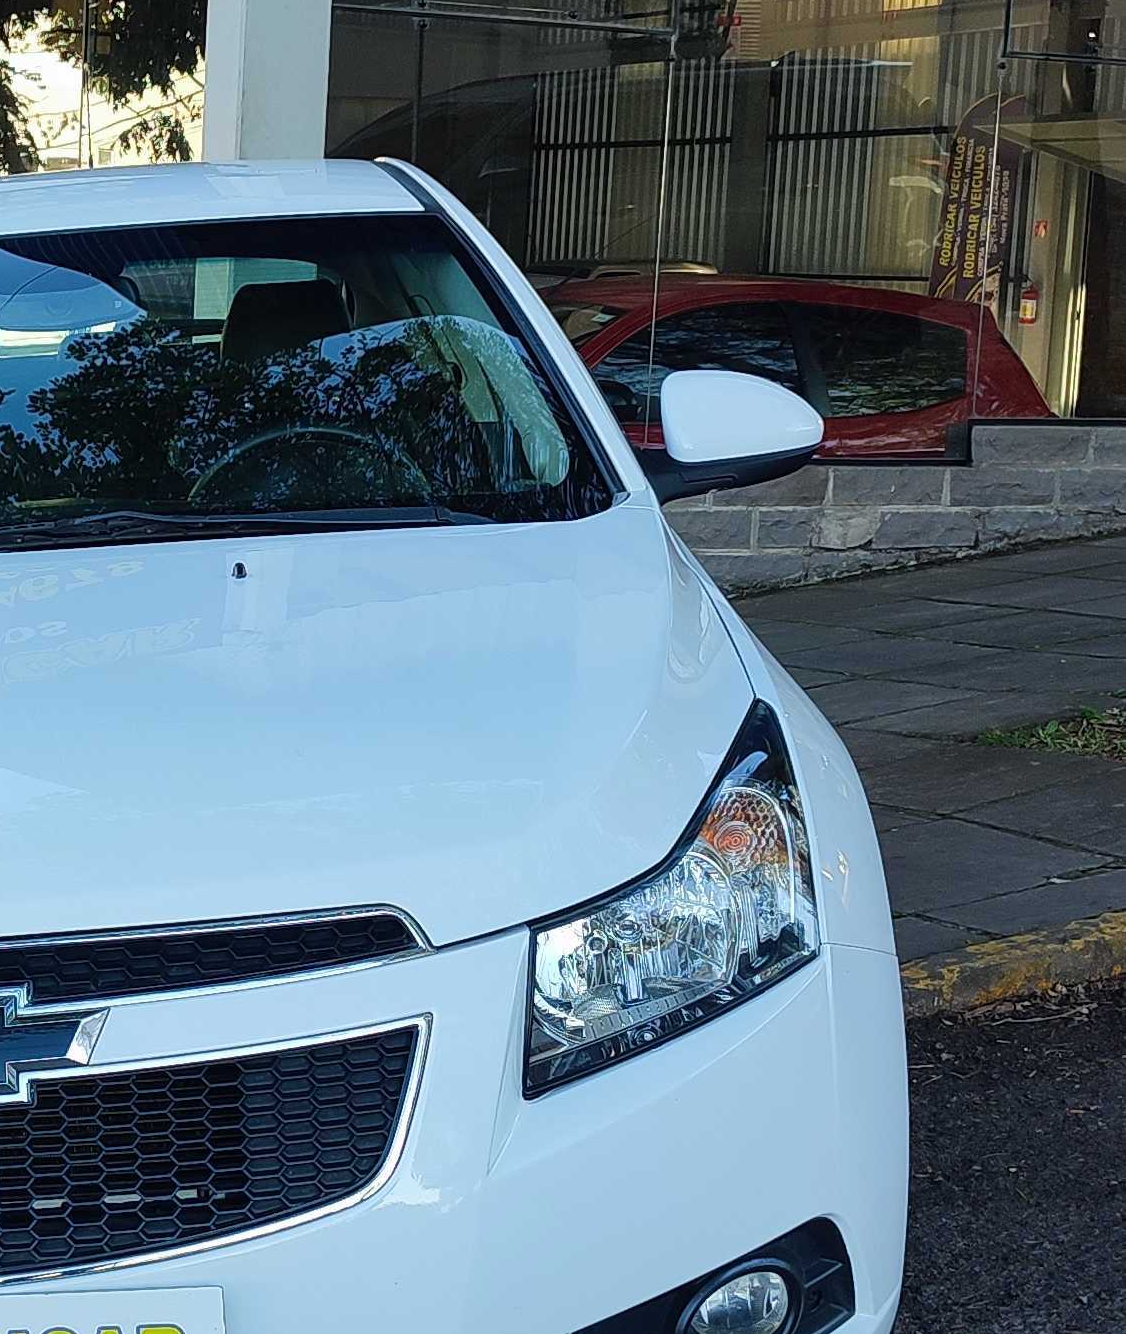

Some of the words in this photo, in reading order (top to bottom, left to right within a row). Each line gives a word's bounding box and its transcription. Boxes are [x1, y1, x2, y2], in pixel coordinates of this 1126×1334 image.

[948, 136, 967, 199] VEICULOS
[970, 145, 987, 209] VEICULOS
[939, 203, 958, 267] RODRICAR
[962, 214, 981, 279] RODRICAR
